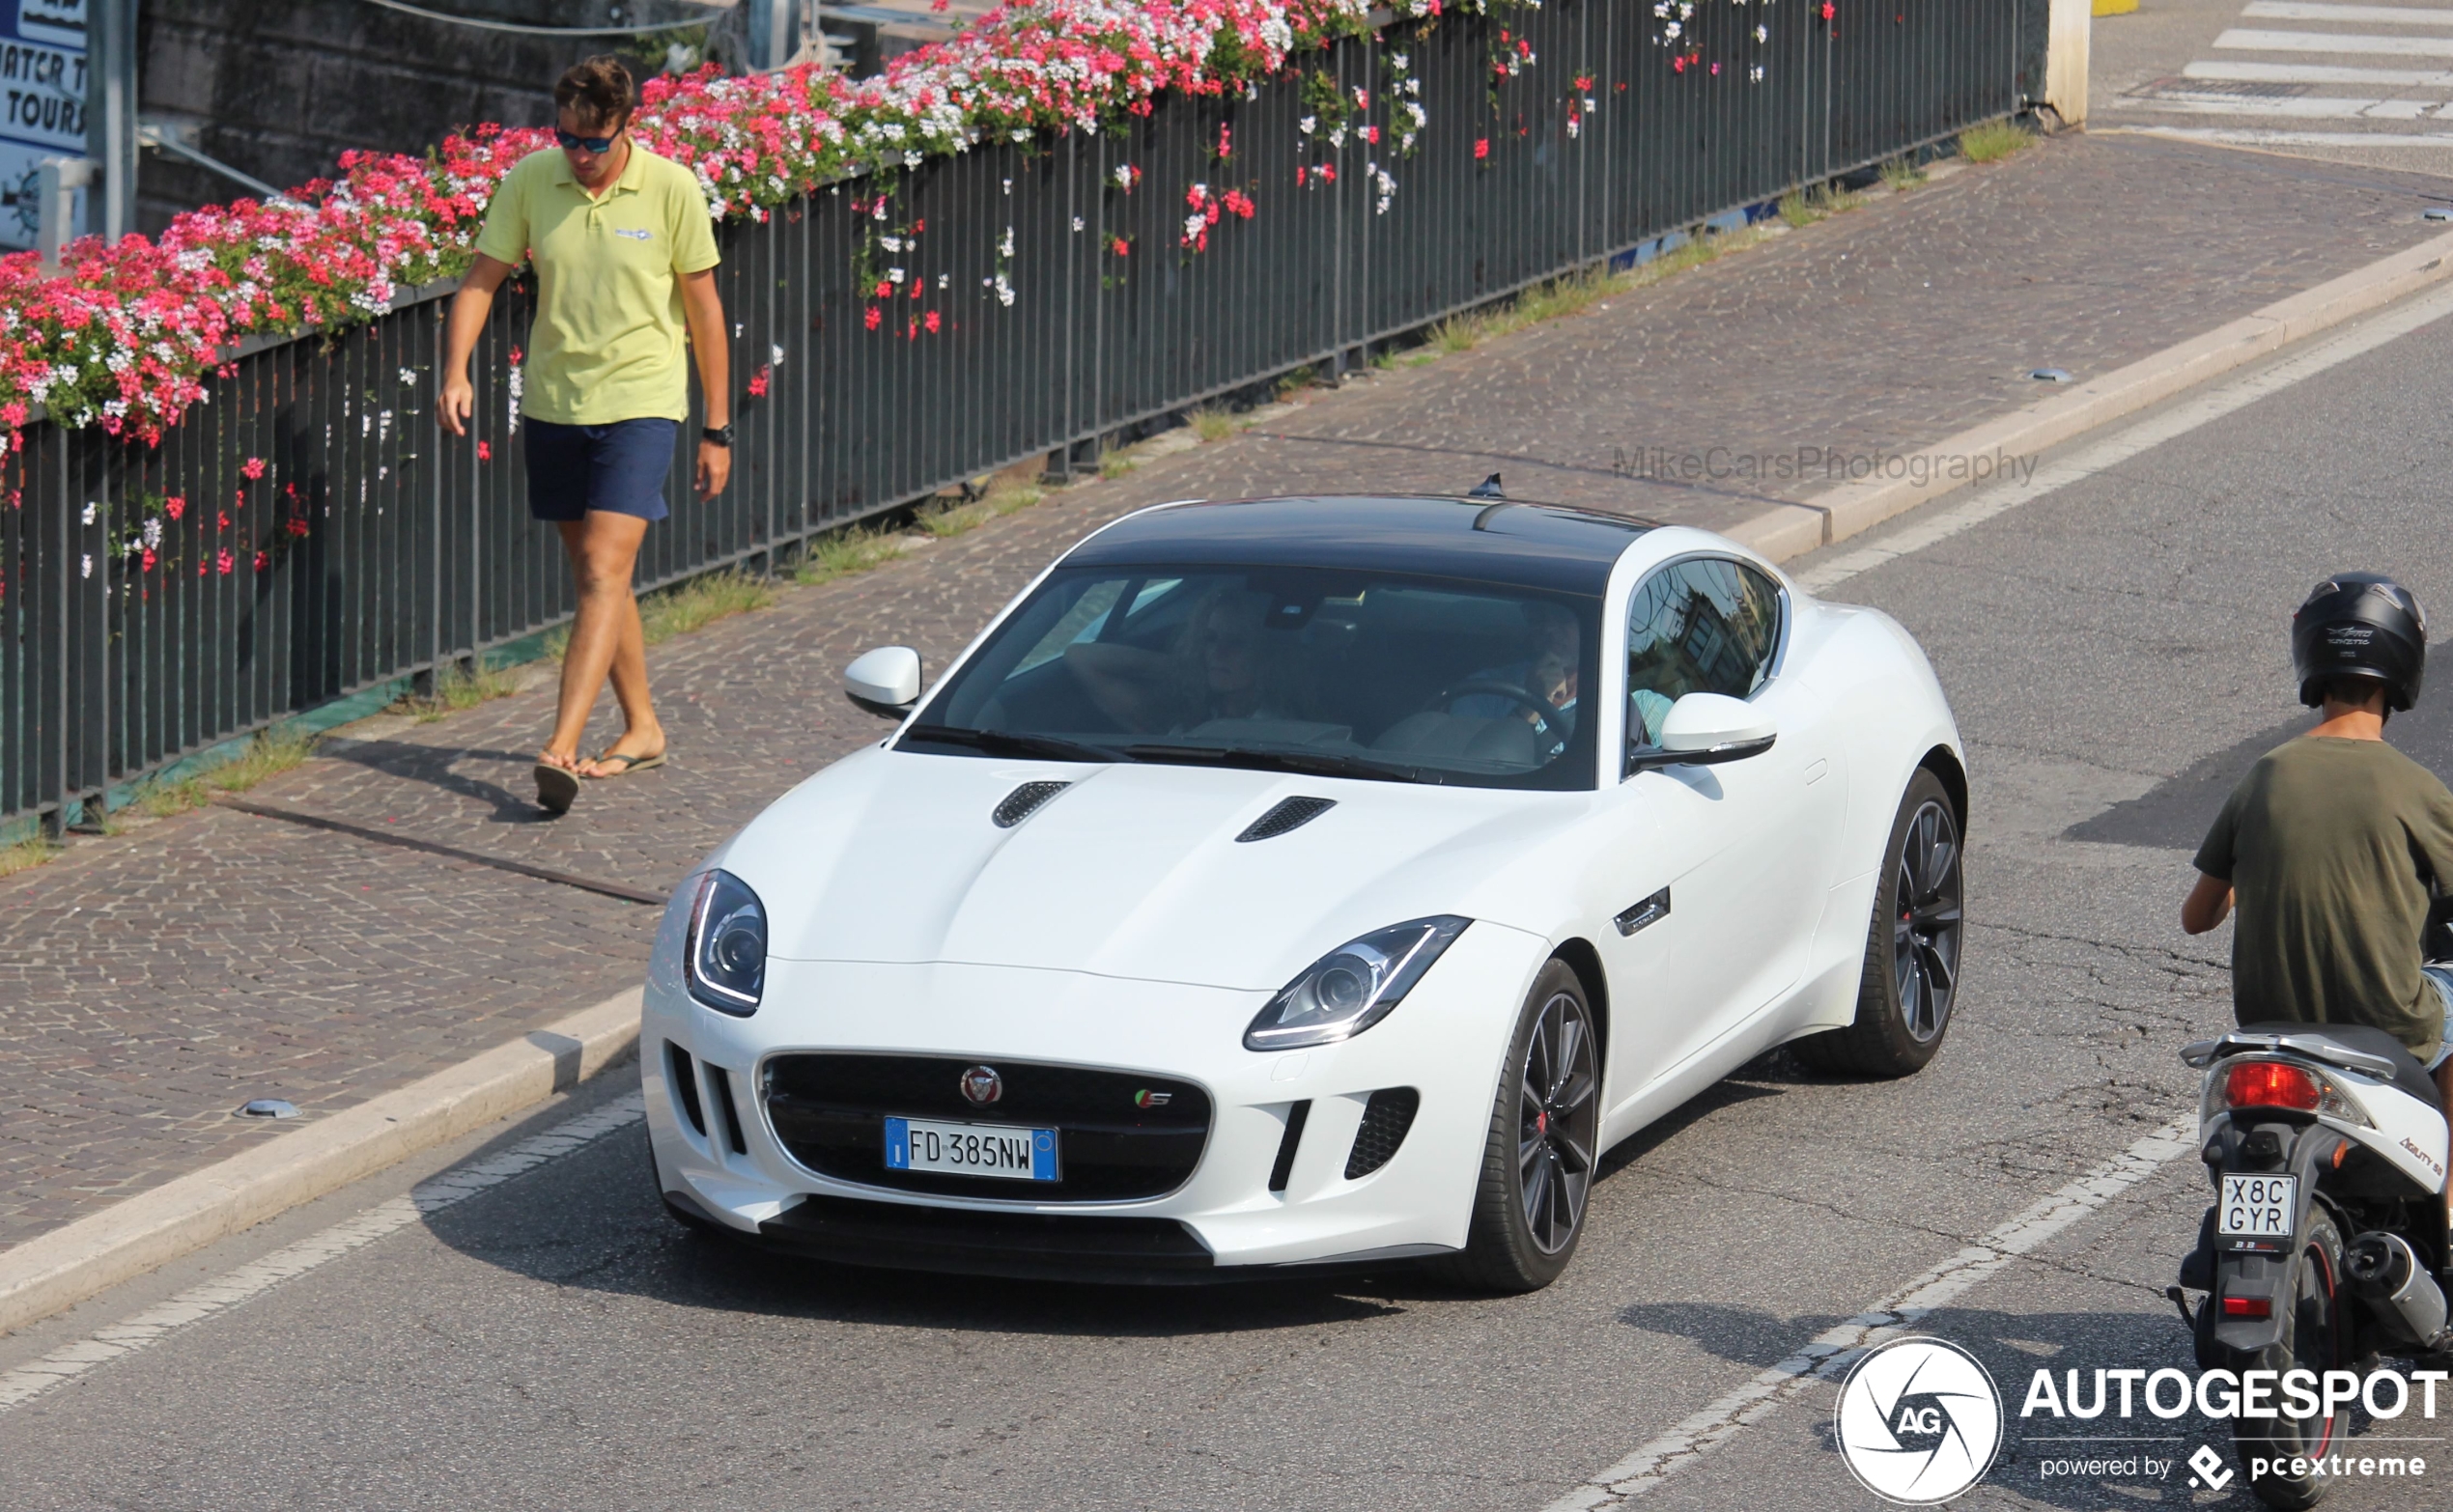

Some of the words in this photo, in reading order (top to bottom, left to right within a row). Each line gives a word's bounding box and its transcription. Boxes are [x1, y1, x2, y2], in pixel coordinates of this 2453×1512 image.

[0, 42, 64, 85] ATER
[2398, 1136, 2433, 1166] AGILITY
[2231, 1179, 2284, 1204] X8C
[2229, 1207, 2282, 1232] GYR
